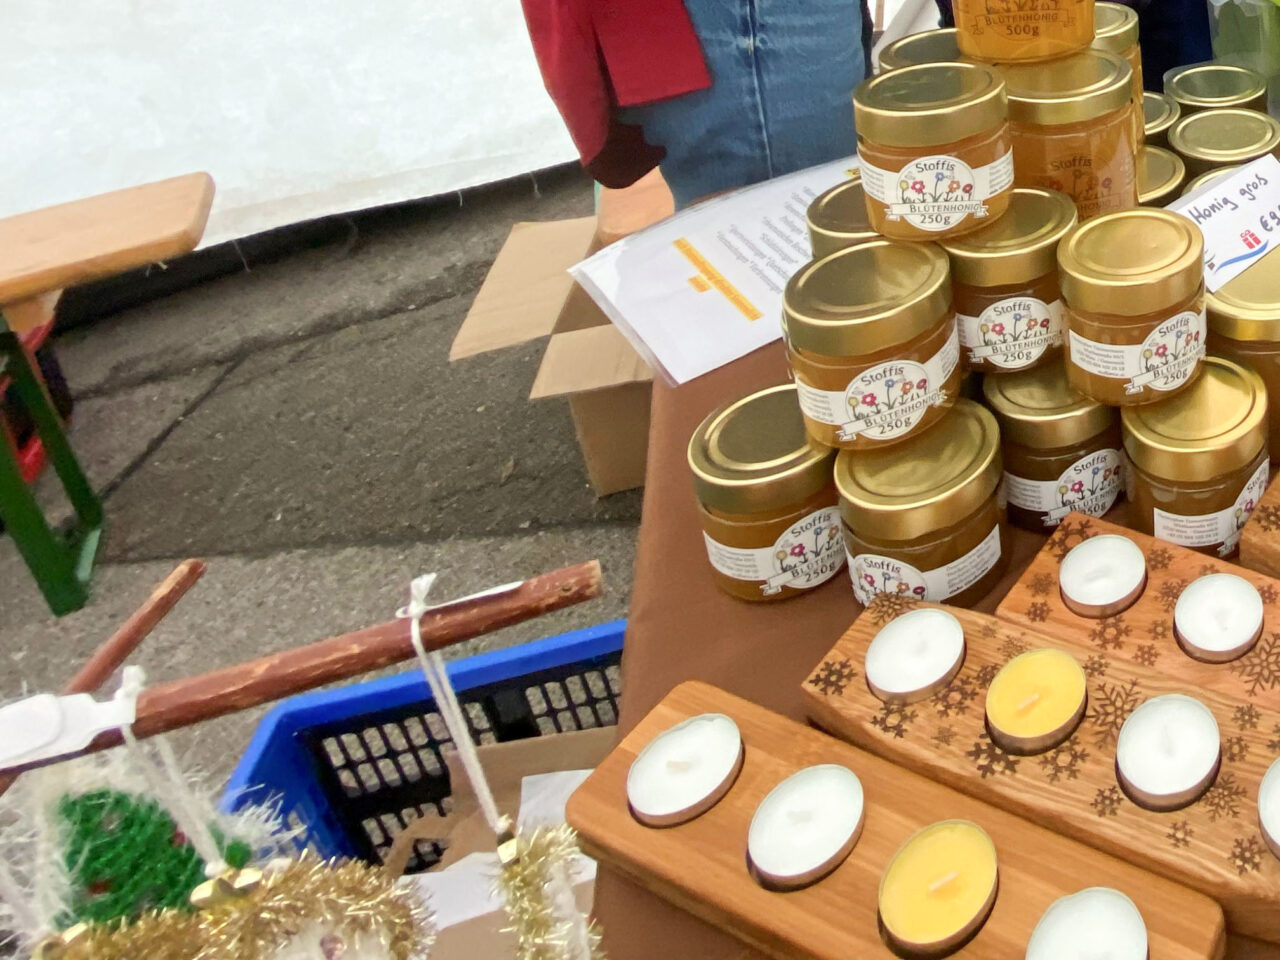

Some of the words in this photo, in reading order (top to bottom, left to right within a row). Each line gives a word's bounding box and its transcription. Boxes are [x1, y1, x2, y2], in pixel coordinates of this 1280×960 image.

[1006, 24, 1040, 37] 500g
[915, 159, 956, 174] Stoffis
[919, 213, 951, 226] 250g
[1188, 197, 1239, 225] Honig
[993, 301, 1032, 317] Stoffis
[1158, 317, 1190, 338] Stoffis
[1003, 351, 1032, 363] 250g
[861, 366, 905, 386] Stoffis
[1163, 368, 1188, 385] 250g
[879, 416, 912, 435] 250g
[1074, 454, 1109, 475] Stoffis
[791, 512, 833, 538] Stoffis
[805, 562, 836, 583] 250g
[863, 557, 902, 574] Stoffis
